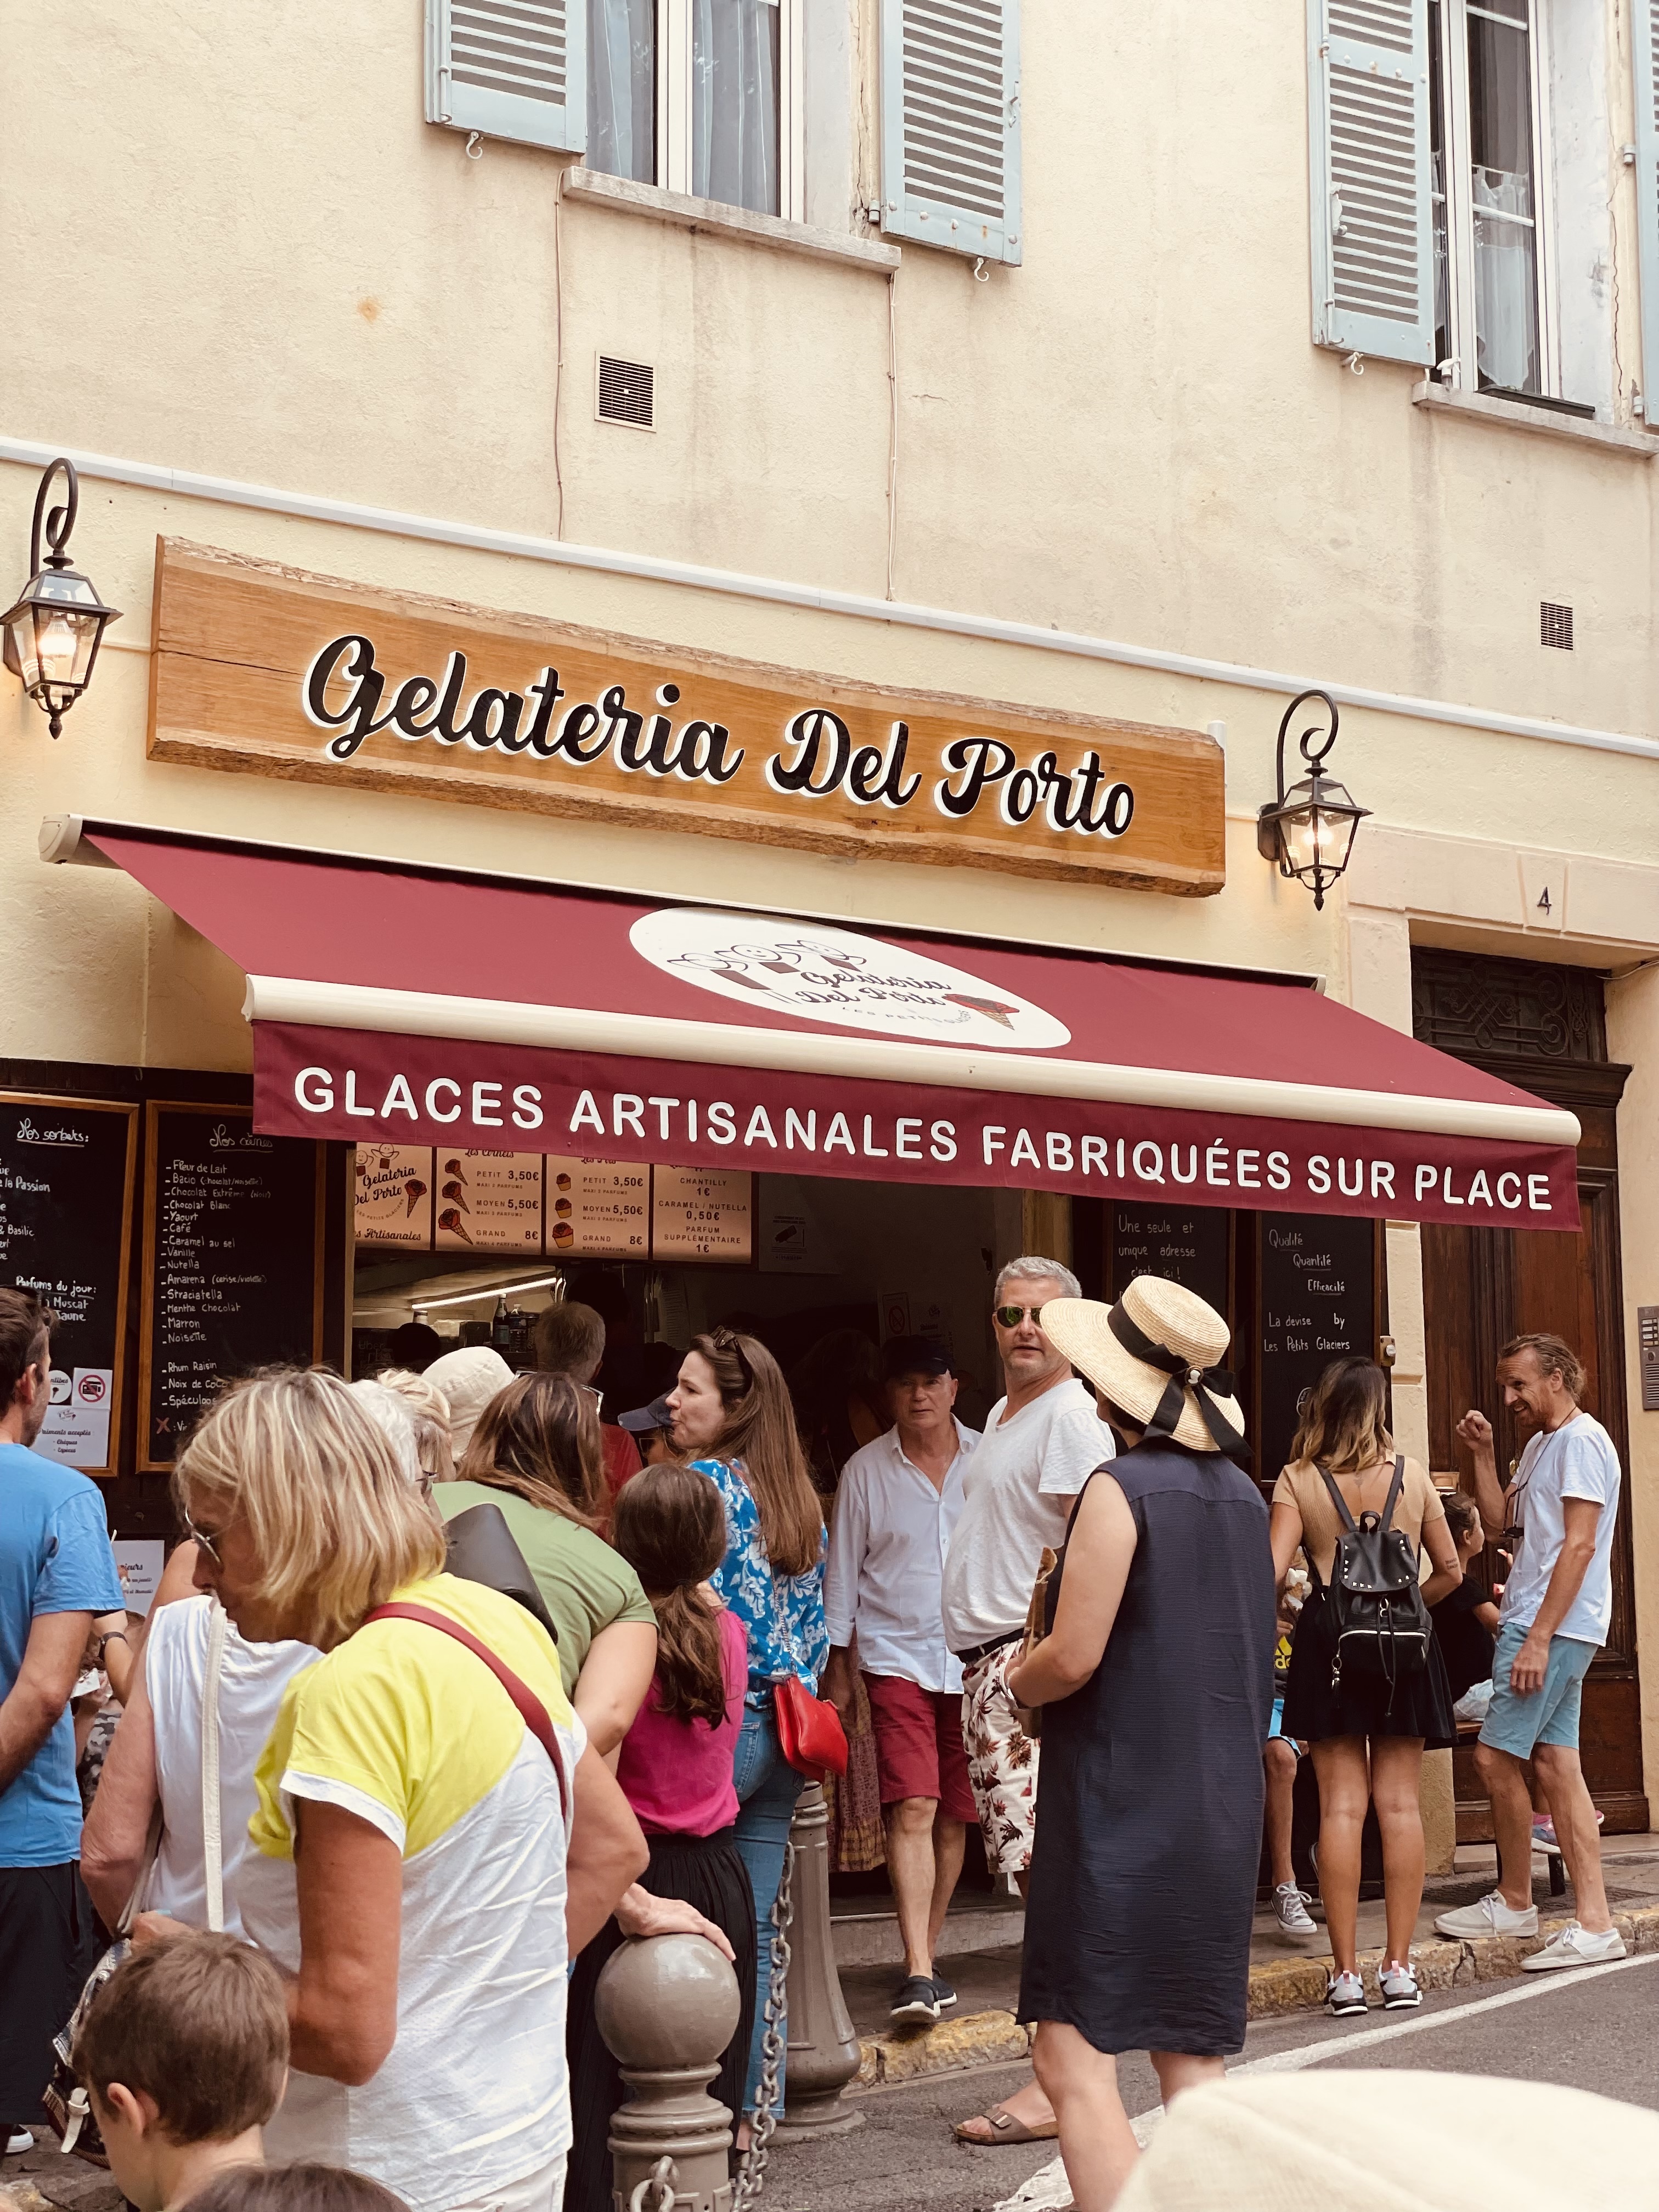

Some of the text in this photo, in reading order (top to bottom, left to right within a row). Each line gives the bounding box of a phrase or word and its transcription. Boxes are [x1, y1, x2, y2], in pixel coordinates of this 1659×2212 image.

[302, 634, 1134, 838] Gelateria Del Porto
[1537, 887, 1552, 916] 4
[800, 969, 952, 990] Gelateria
[795, 988, 946, 1006] Del Porto
[17, 1118, 40, 1140] Nos
[210, 1124, 235, 1147] Nos
[295, 1067, 1553, 1211] GLACES ARTISANALES FABRIQUÉES SUR PLACE
[173, 1159, 228, 1173] Fleur de Lait
[173, 1172, 196, 1184] Bacio
[363, 1166, 417, 1189] Gelateria
[508, 1170, 539, 1181] 3,50€
[613, 1176, 643, 1187] 3,50€
[680, 1177, 727, 1186] CHANTILLY
[5, 1178, 13, 1188] la
[15, 1176, 50, 1193] Passion
[171, 1187, 207, 1197] Chocolat
[373, 1185, 402, 1201] Porto
[170, 1200, 231, 1210] Chocolat Blanc
[507, 1199, 539, 1210] 5,50€
[613, 1205, 643, 1216] 5,50€
[709, 1203, 747, 1211] NUTELLA
[170, 1211, 199, 1222] Yaourt
[686, 1210, 720, 1221] 0,50€
[169, 1222, 191, 1233] Café
[1119, 1214, 1194, 1234] Une seule et
[8, 1224, 35, 1237] Basilic
[365, 1228, 421, 1241] Artisanales
[525, 1231, 538, 1240] 8€
[169, 1235, 205, 1246] Caramel
[223, 1238, 235, 1248] sel
[630, 1235, 642, 1245] 8€
[664, 1234, 741, 1244] SUPPLÉMENTAIRE
[1268, 1229, 1303, 1249] Qualité
[167, 1246, 196, 1257] Vanille
[1119, 1244, 1196, 1260] unique adresse
[167, 1259, 200, 1269] Nutella
[1293, 1253, 1331, 1268] Quantité
[16, 1276, 52, 1290] Parfums
[57, 1280, 68, 1291] du
[167, 1274, 205, 1285] Amarena
[1308, 1279, 1345, 1291] Efficacité
[167, 1289, 223, 1300] Straciatella
[54, 1296, 89, 1309] Muscat
[167, 1302, 241, 1313] Menthe Chocolat
[168, 1317, 201, 1329] Marron
[1269, 1312, 1345, 1330] La devise by
[168, 1332, 207, 1344] Noisette
[1264, 1335, 1350, 1352] Les Petits Glaciers
[168, 1359, 217, 1373] Rhum Raisin
[168, 1378, 187, 1389] Noix
[192, 1379, 202, 1389] de
